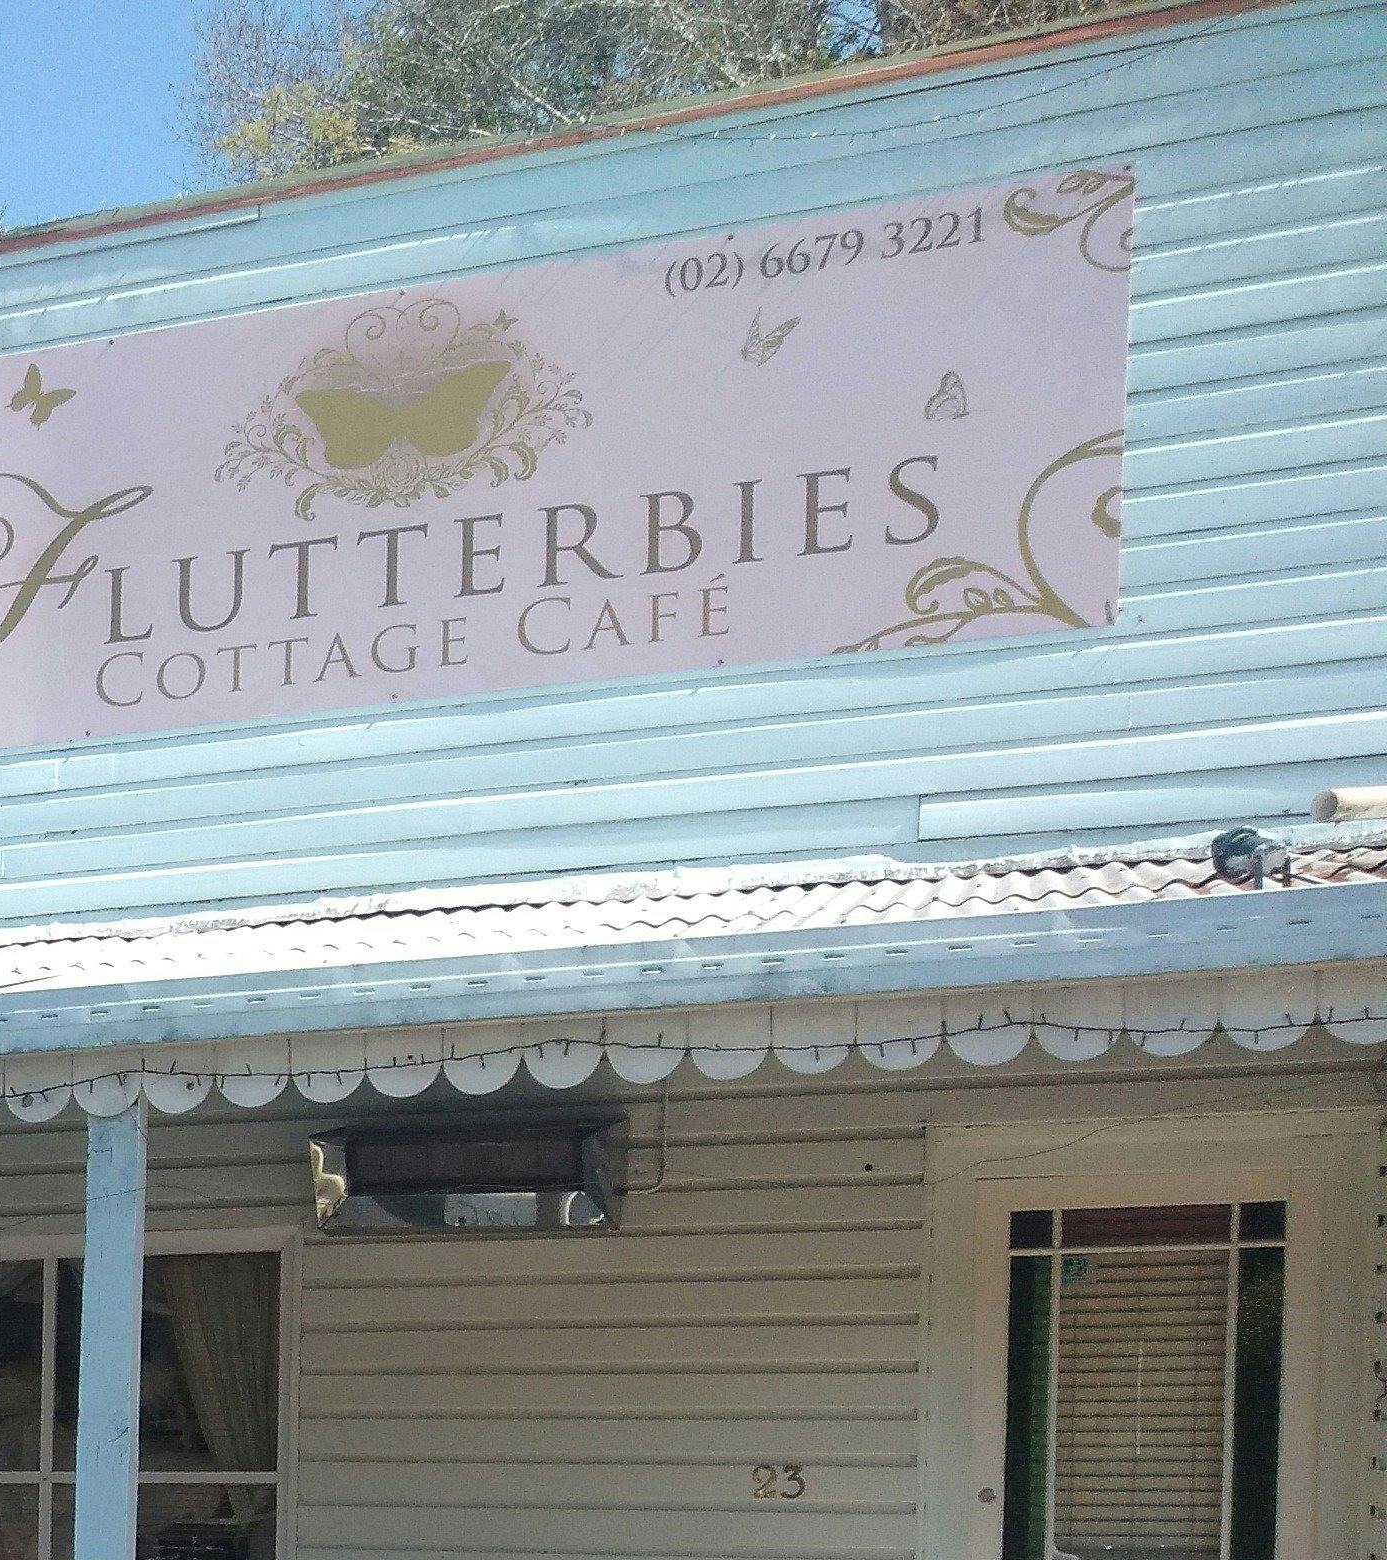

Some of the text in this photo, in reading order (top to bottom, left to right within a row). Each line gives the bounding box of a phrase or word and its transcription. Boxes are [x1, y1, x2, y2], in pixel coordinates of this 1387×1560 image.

[664, 206, 986, 298] (02) 6679 3221
[95, 571, 731, 707] COTTAGE CAFÉ
[752, 1464, 806, 1499] 23
